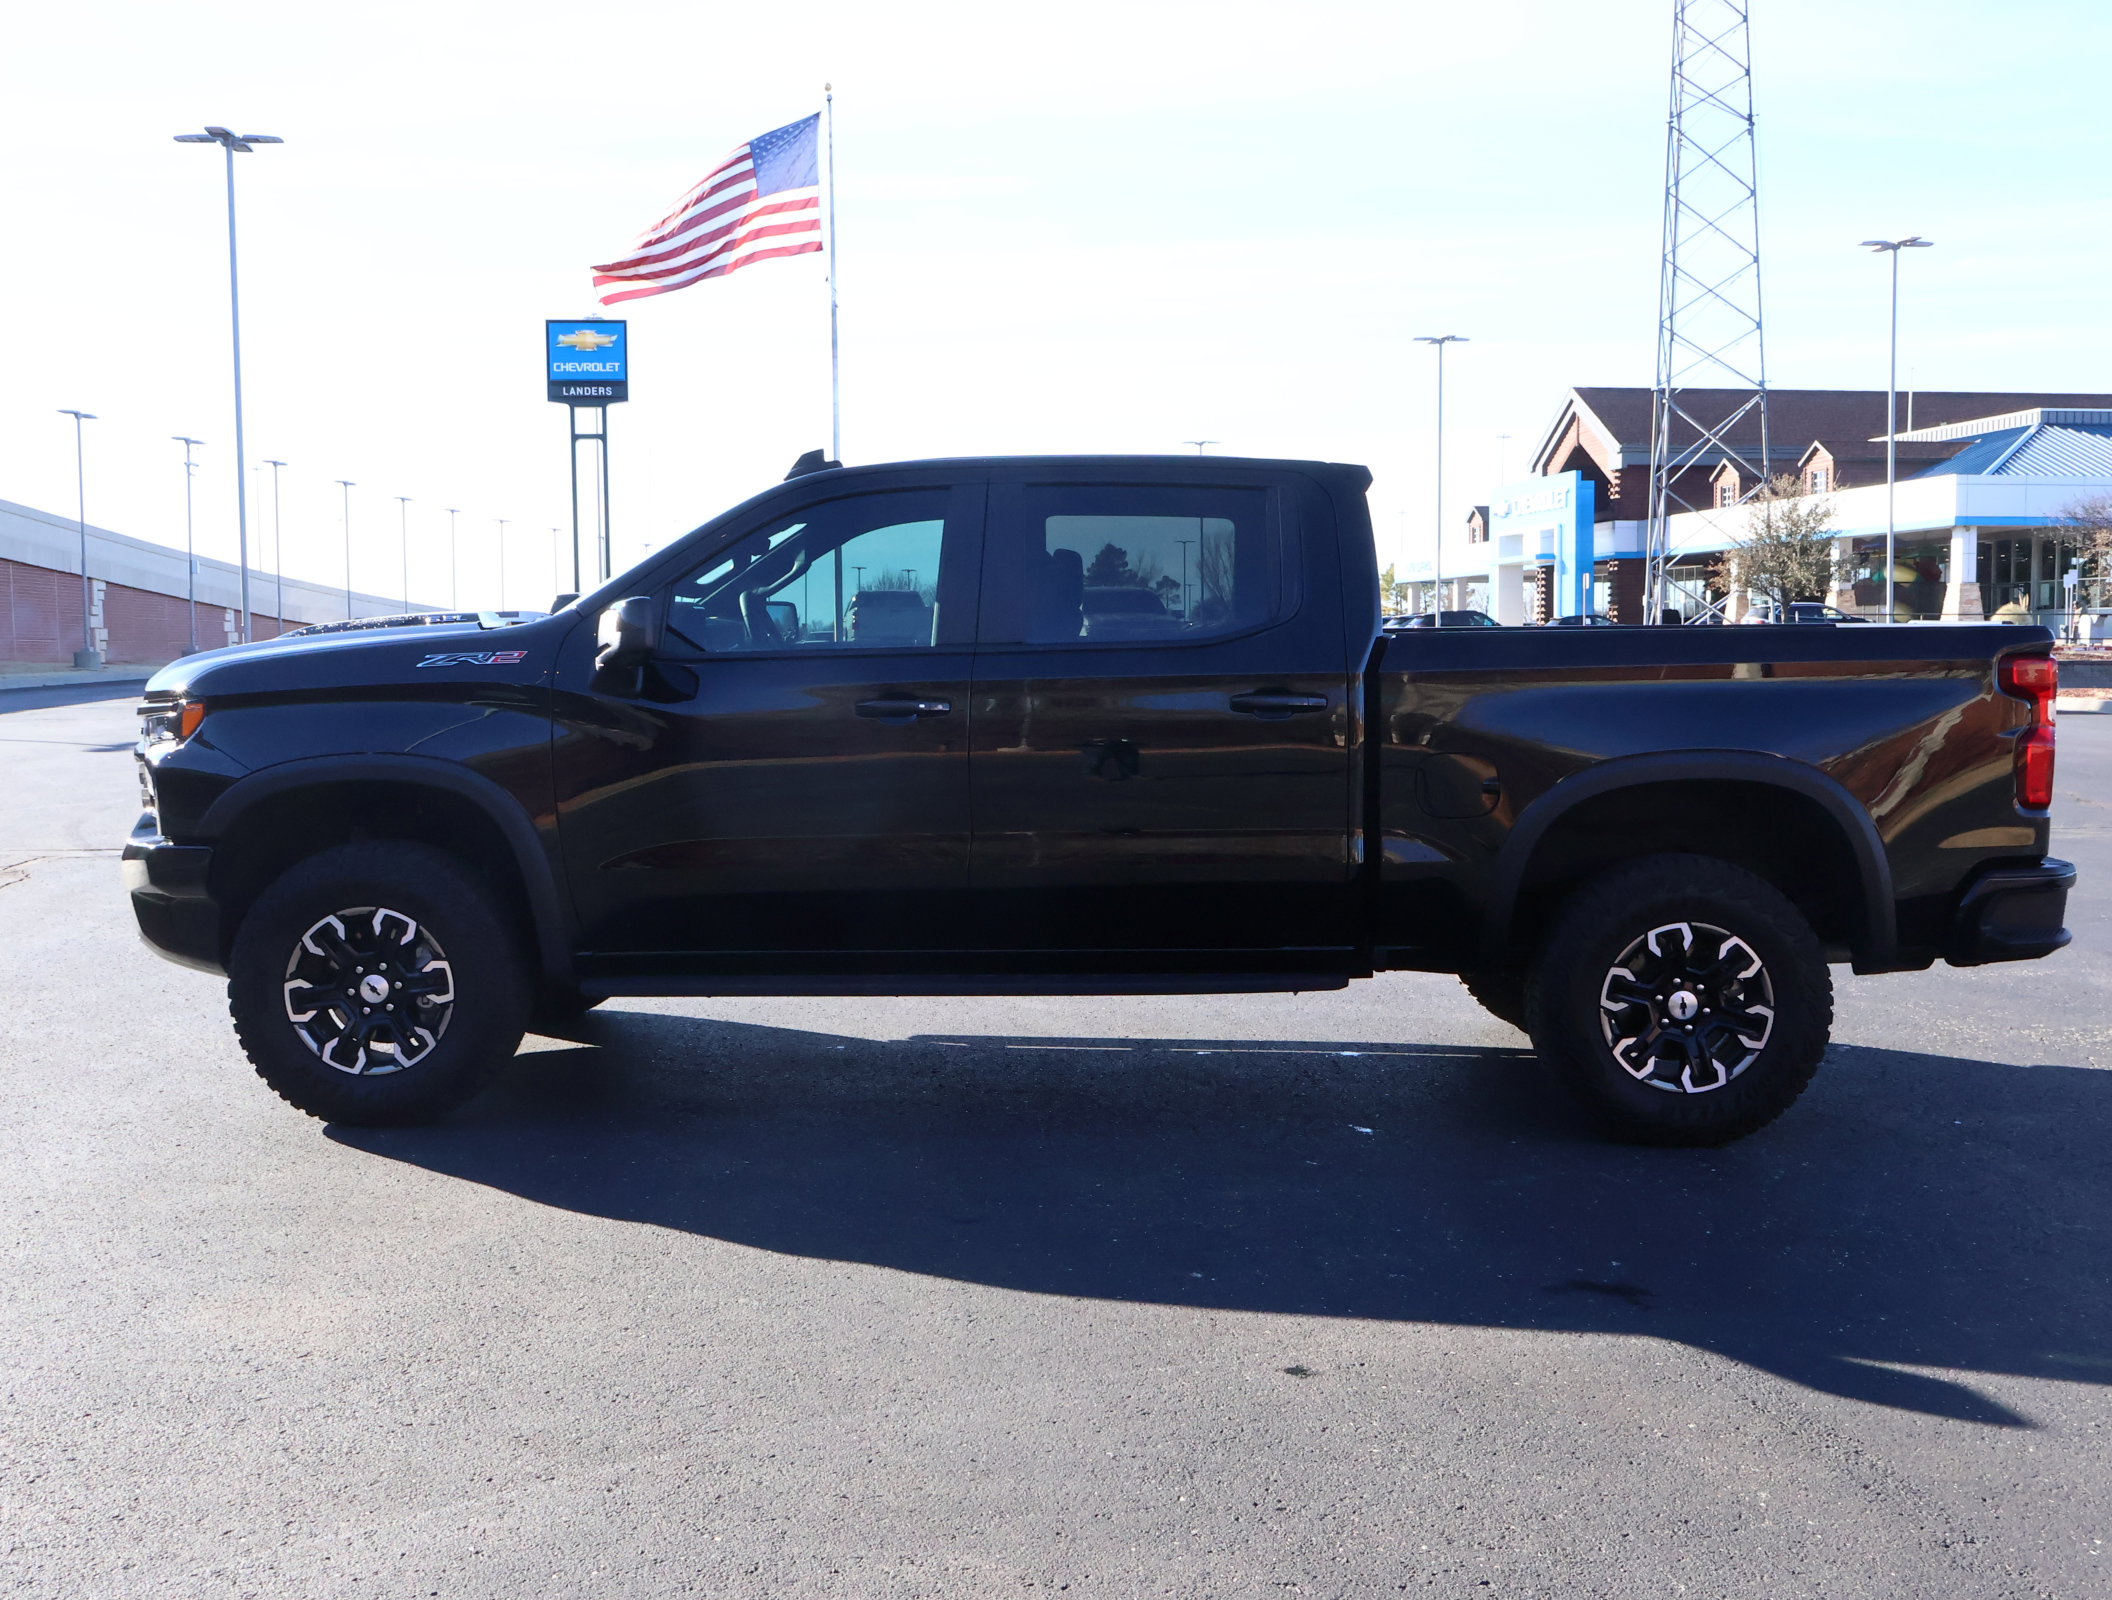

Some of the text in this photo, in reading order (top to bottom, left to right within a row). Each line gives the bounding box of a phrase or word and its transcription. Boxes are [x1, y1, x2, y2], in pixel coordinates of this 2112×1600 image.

[553, 362, 620, 372] CHEVROLET
[562, 386, 613, 396] LANDERS
[416, 650, 528, 667] ZR2
